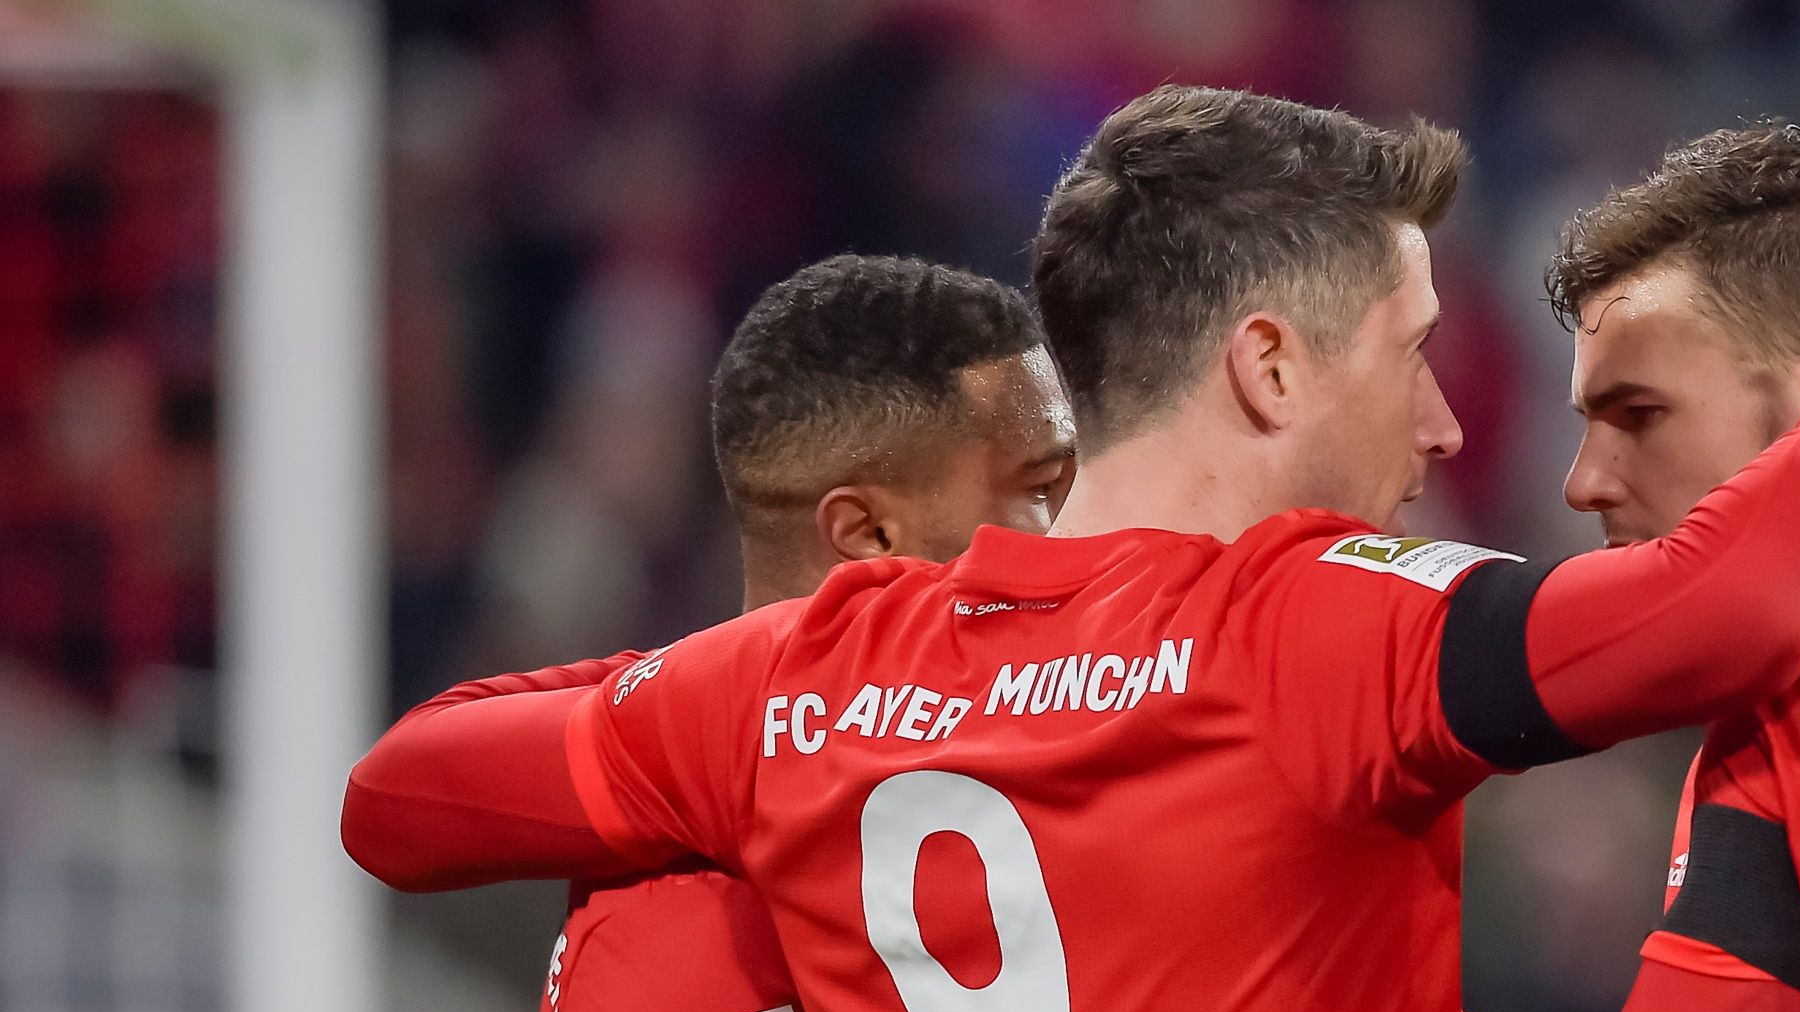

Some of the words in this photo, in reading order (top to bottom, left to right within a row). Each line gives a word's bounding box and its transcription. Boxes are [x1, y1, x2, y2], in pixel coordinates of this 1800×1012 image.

[763, 692, 827, 757] FC
[833, 682, 973, 741] AYER
[983, 637, 1194, 716] MÜNCHN
